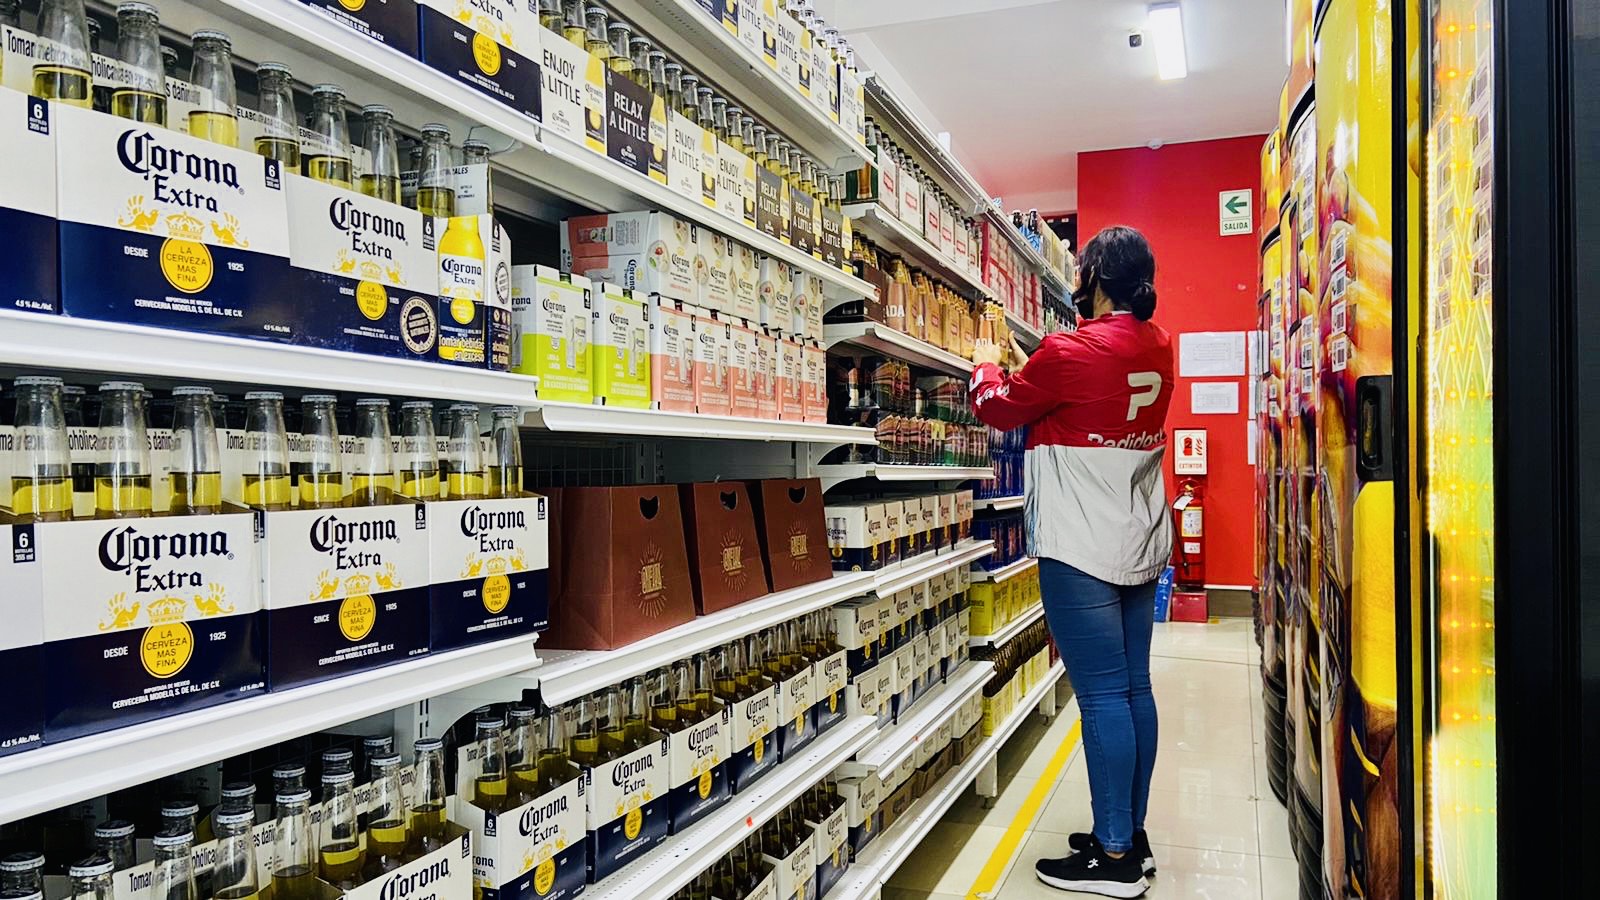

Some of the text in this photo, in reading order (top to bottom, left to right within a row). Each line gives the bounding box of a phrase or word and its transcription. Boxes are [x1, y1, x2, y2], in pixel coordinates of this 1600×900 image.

[778, 24, 796, 46] ENJOY
[6, 29, 35, 58] Tomar
[543, 48, 575, 81] ENJOY
[548, 76, 581, 106] LITTLE
[34, 104, 43, 119] 6
[614, 91, 643, 121] RELAX
[609, 111, 647, 142] A LITTLE
[675, 128, 696, 151] ENJOY
[117, 129, 240, 189] Corona
[671, 146, 700, 172] A LITTLE
[268, 165, 276, 178] 6
[720, 158, 739, 178] ENJOY
[716, 173, 742, 197] A LITTLE
[761, 181, 777, 203] RELAX
[153, 173, 218, 213] Extra
[764, 198, 780, 217] LITTLE
[795, 201, 810, 220] RELAX
[329, 197, 406, 240] Corona
[823, 218, 839, 234] RELAX
[425, 222, 432, 234] 6
[798, 219, 813, 234] LITTLE
[1224, 222, 1248, 231] SALIDA
[124, 245, 149, 258] DESDE
[180, 246, 192, 255] LA
[351, 231, 392, 260] Extra
[166, 254, 207, 266] CERVEZA
[227, 262, 244, 272] 1925
[441, 257, 482, 276] Corona
[177, 264, 198, 274] MAS
[177, 273, 198, 284] FINA
[454, 273, 476, 286] Extra
[359, 291, 384, 301] CERVEZA
[366, 299, 378, 307] MAS
[366, 305, 378, 313] FINA
[542, 298, 567, 313] Corona
[610, 312, 629, 326] Corona
[1126, 371, 1162, 421] P
[417, 509, 423, 520] 6
[539, 502, 544, 512] 6
[461, 506, 525, 542] Corona
[18, 532, 29, 547] 6
[310, 515, 397, 556] Corona
[479, 534, 514, 552] Extra
[98, 526, 229, 576] Corona
[336, 549, 381, 570] Extra
[135, 565, 203, 593] Extra
[493, 579, 500, 587] LA
[463, 589, 476, 598] DESDE
[485, 585, 508, 595] CERVEZA
[353, 600, 362, 609] LA
[313, 613, 330, 624] SINCE
[343, 607, 372, 619] CERVEZA
[350, 616, 364, 625] MAS
[160, 629, 173, 639] LA
[350, 623, 364, 633] FINA
[209, 631, 226, 641] 1925
[146, 638, 188, 651] CERVEZA
[104, 646, 128, 659] DESDE
[157, 649, 176, 658] MAS
[156, 658, 176, 669] FINA
[824, 656, 843, 677] Corona
[790, 673, 809, 697] Corona
[112, 694, 149, 710] CERVECERIA
[149, 690, 174, 702] MODELO,
[181, 686, 189, 696] DE
[201, 682, 209, 692] DE
[746, 695, 769, 721] Corona
[752, 714, 765, 728] Extra
[688, 722, 719, 751] Corona
[697, 744, 714, 759] Extra
[612, 754, 653, 787] Corona
[623, 778, 645, 796] Extra
[519, 794, 568, 837] Corona
[488, 818, 494, 829] 6
[532, 825, 559, 847] Extra
[463, 839, 468, 849] 6
[473, 855, 495, 868] rona
[129, 868, 153, 892] Tomar
